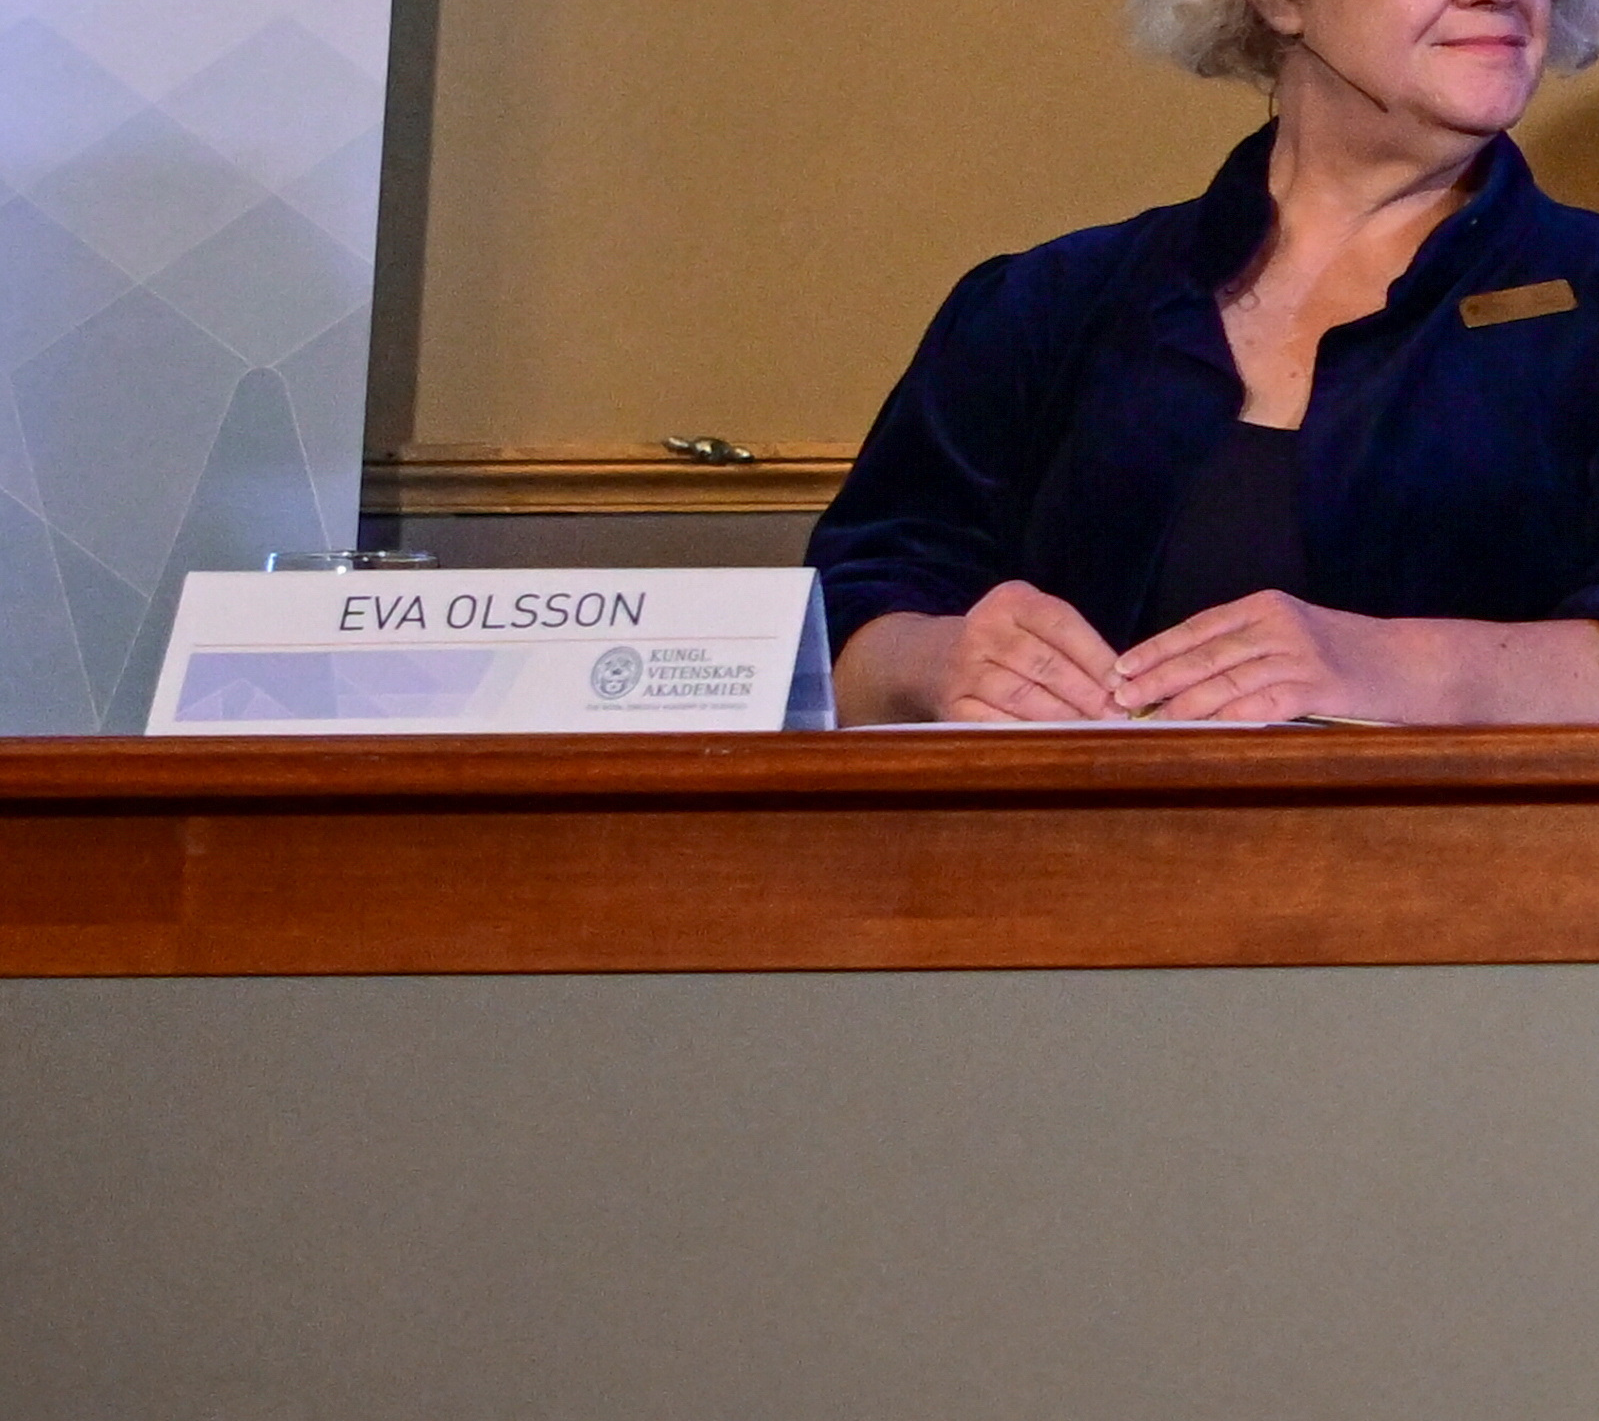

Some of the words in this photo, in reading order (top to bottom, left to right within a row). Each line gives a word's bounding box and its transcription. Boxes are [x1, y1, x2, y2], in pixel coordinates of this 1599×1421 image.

[339, 596, 425, 631] EVA
[447, 593, 645, 629] OLSSON
[642, 683, 752, 697] AKADEMIEN
